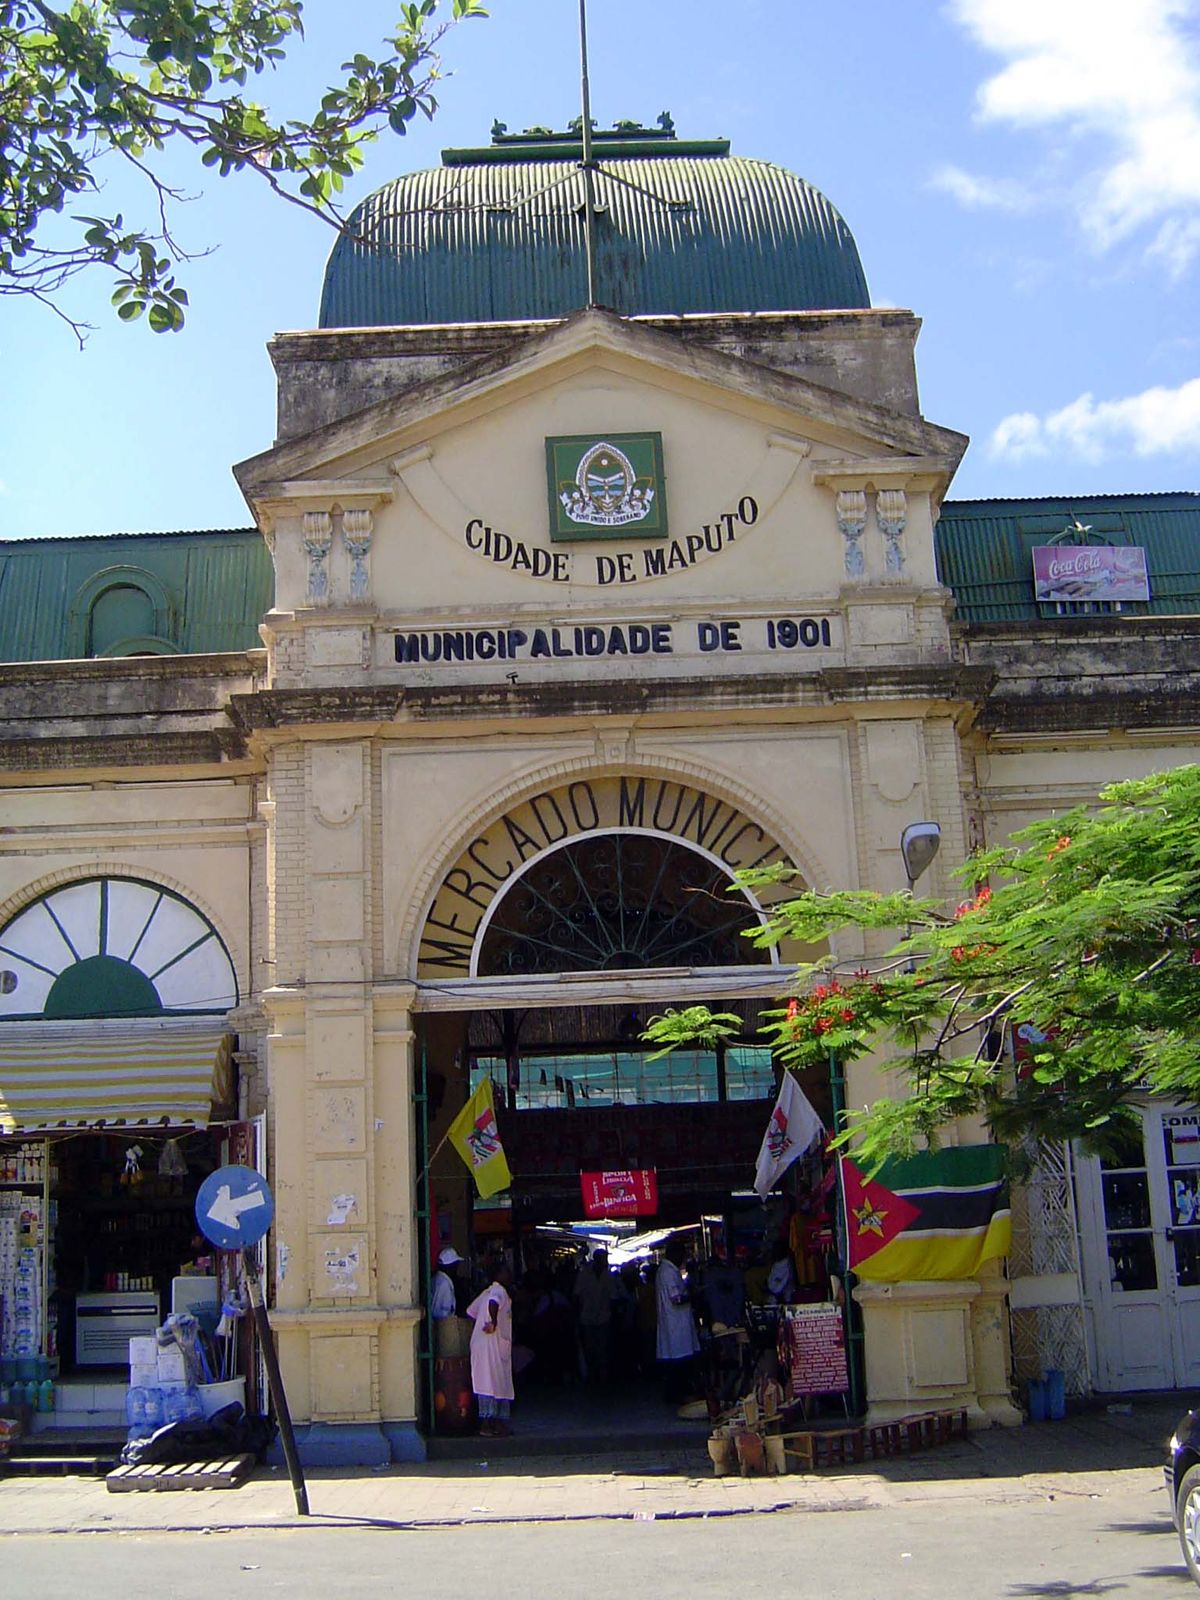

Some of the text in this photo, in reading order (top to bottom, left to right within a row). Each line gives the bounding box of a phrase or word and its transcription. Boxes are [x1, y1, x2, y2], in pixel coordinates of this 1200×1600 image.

[466, 496, 759, 585] CIDADE DE MAPUTO
[394, 618, 832, 663] MUNICIPALIDADE DE 1901
[418, 780, 600, 970] MERCADO
